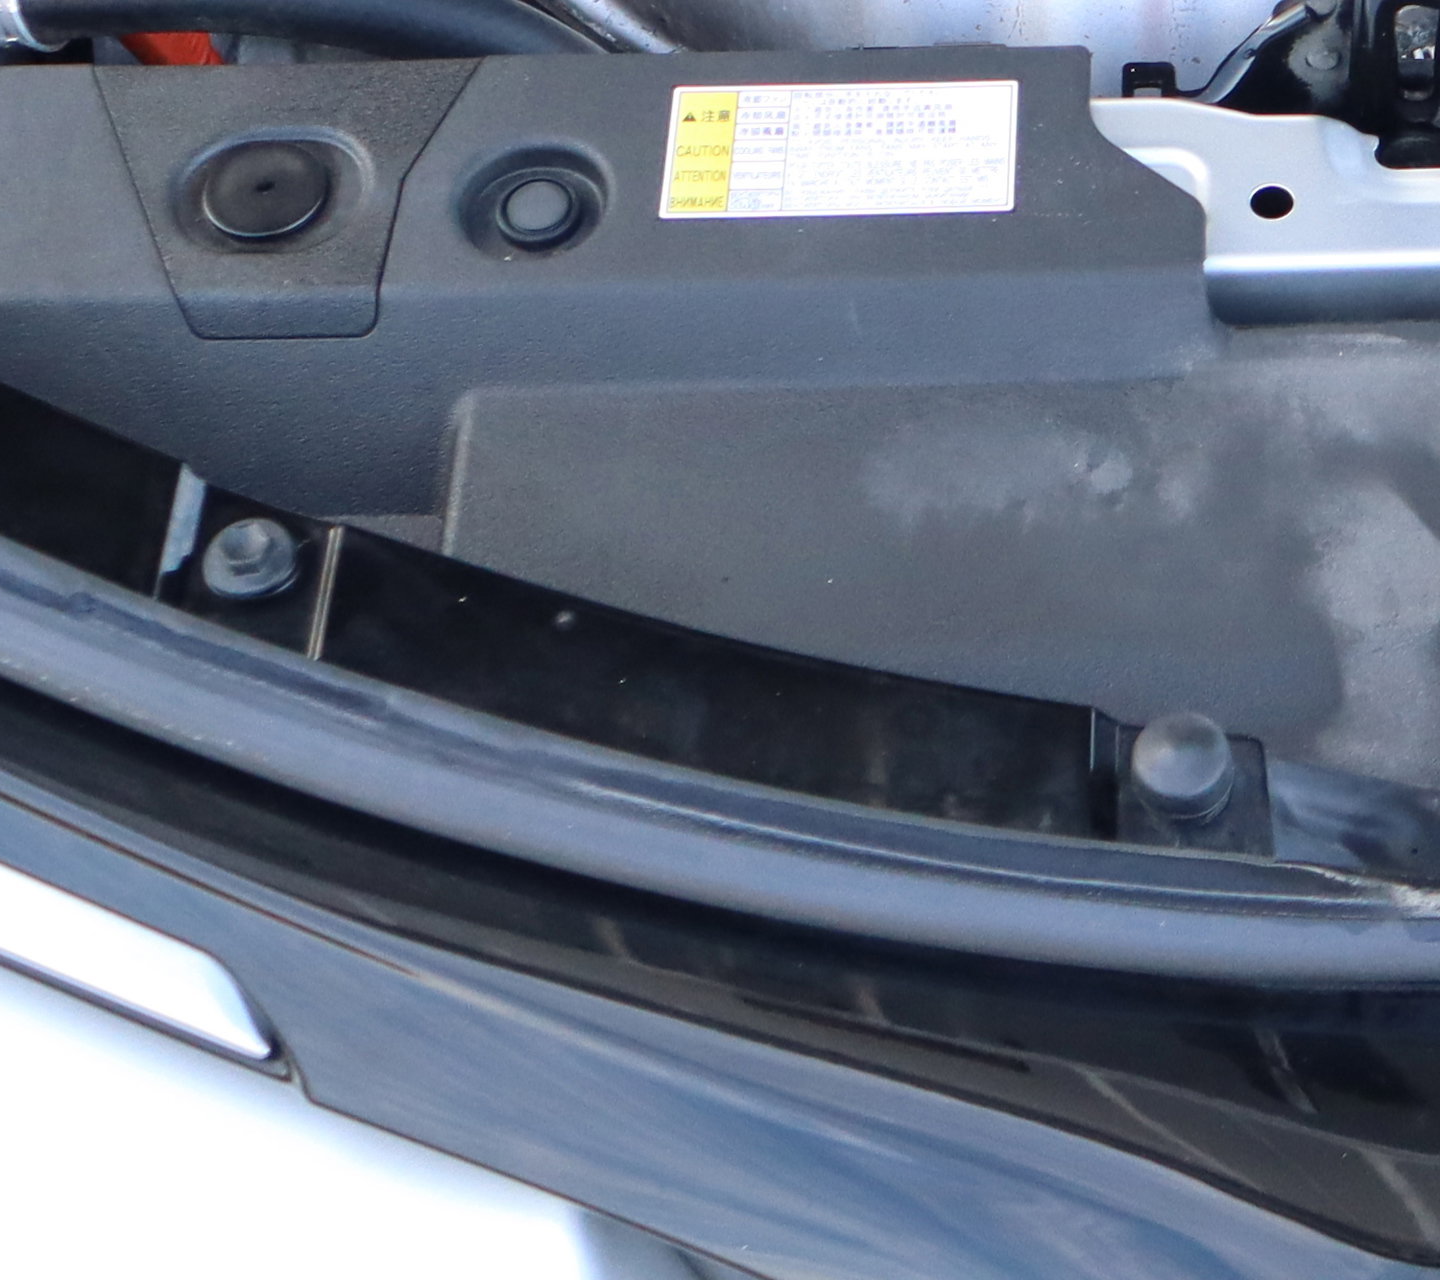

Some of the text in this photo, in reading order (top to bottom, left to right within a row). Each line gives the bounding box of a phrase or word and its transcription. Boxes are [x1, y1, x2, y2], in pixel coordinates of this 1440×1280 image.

[701, 110, 730, 122] 注意
[676, 145, 730, 157] CAUTION
[674, 170, 727, 182] ATTENTION
[669, 196, 724, 208] ВНИМАНИЕ
